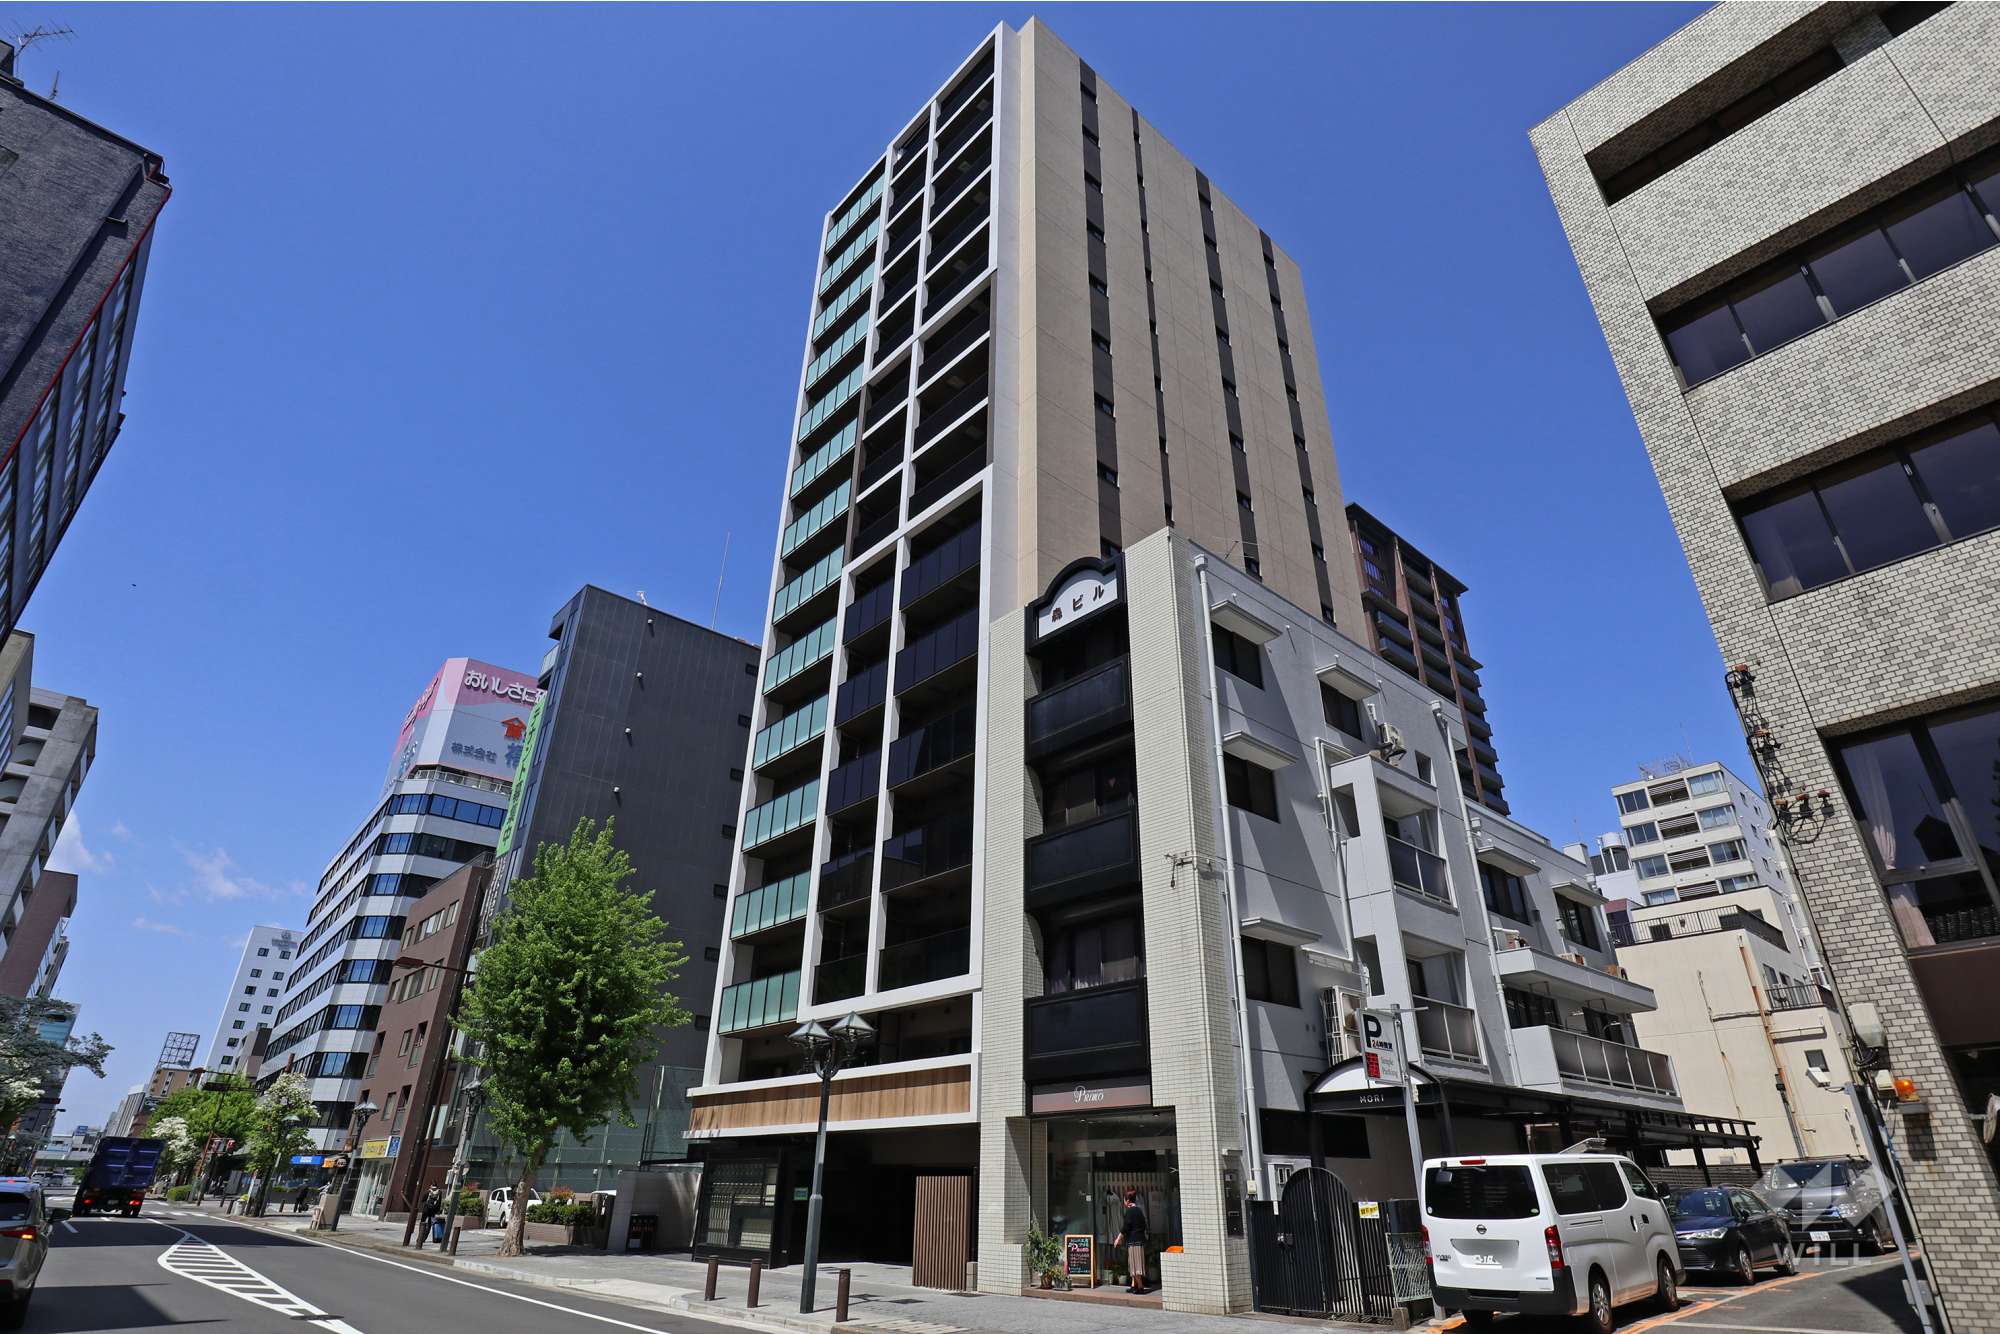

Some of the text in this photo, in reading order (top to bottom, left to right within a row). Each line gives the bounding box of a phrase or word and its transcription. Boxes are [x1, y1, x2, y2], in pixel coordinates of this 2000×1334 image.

[451, 741, 497, 764] 株式会社
[1363, 1014, 1382, 1048] P
[1359, 1094, 1384, 1104] MORI
